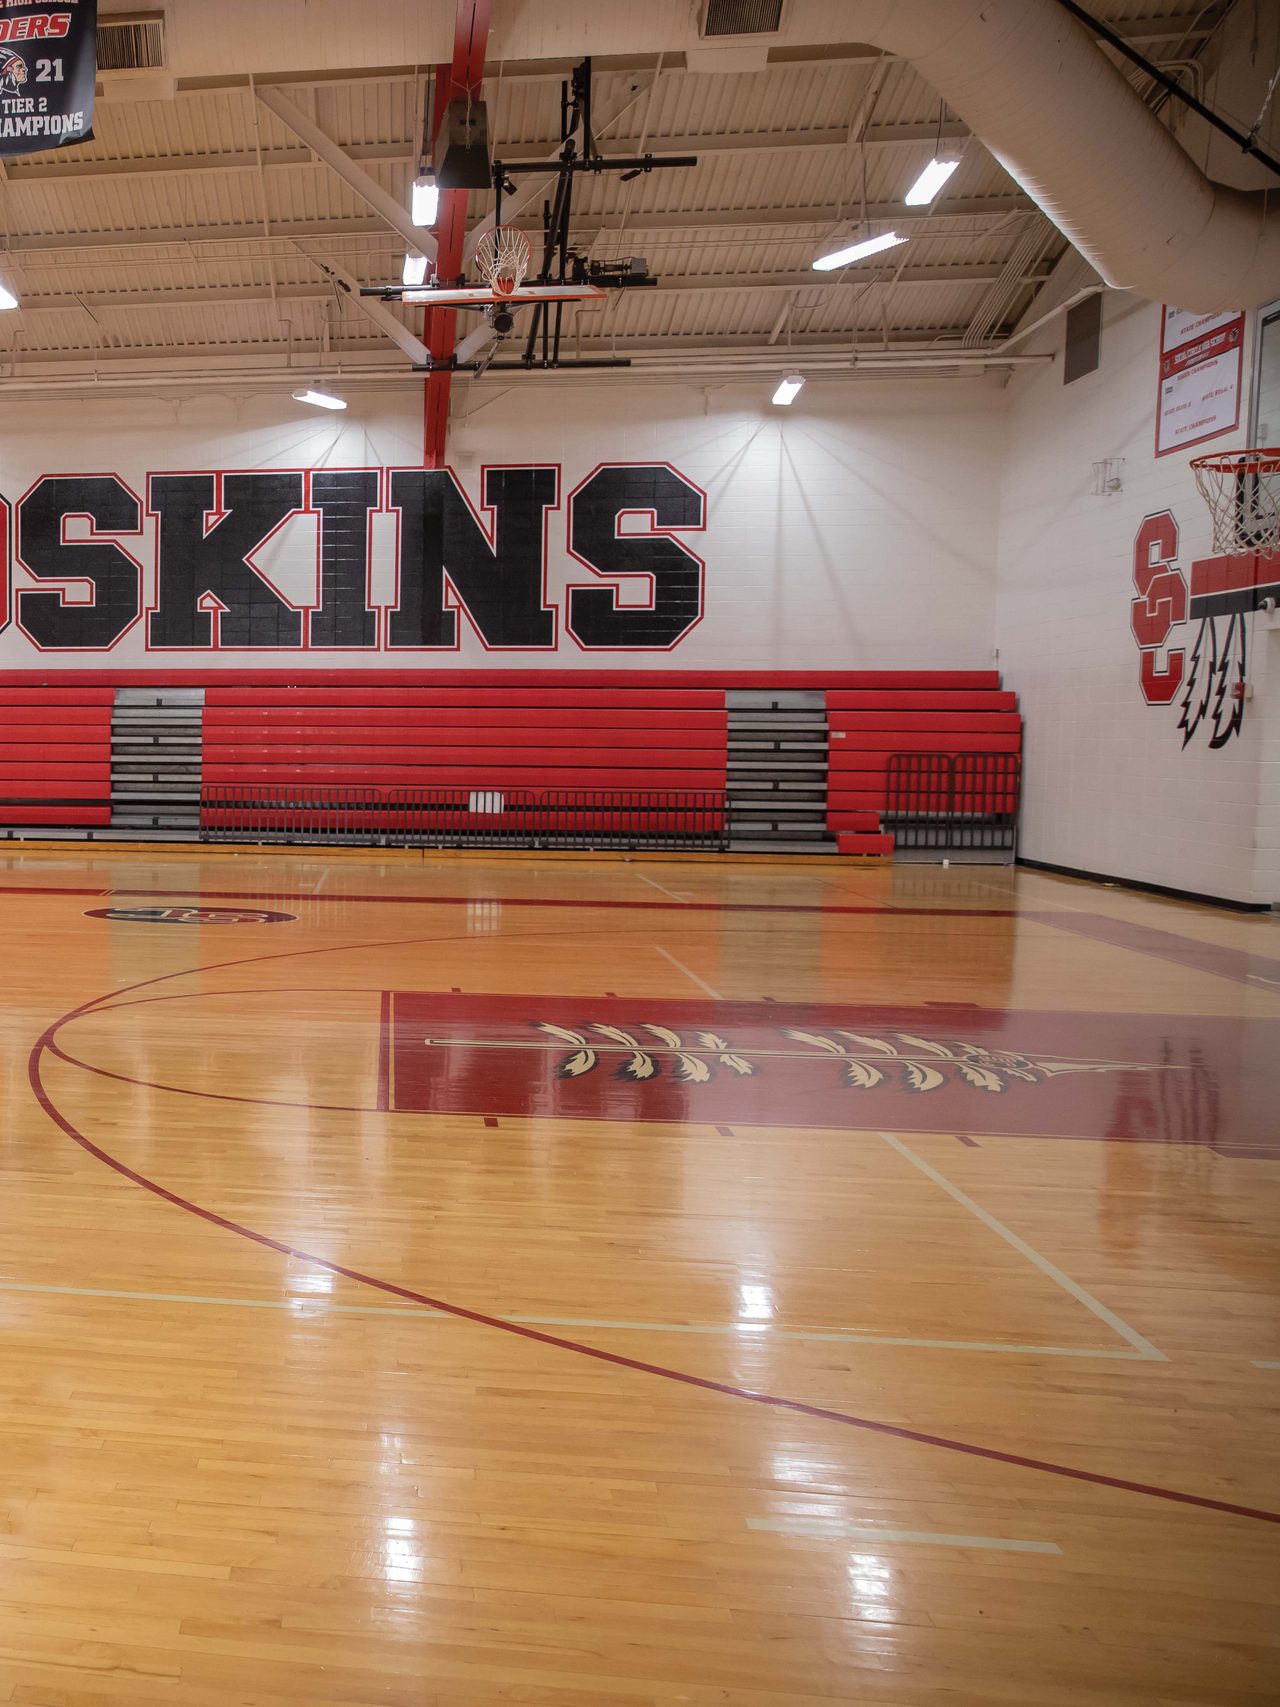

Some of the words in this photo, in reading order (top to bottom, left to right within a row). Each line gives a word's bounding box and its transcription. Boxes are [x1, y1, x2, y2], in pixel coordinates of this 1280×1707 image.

[35, 59, 64, 83] 21
[1, 99, 34, 115] TIER
[38, 97, 48, 112] 2
